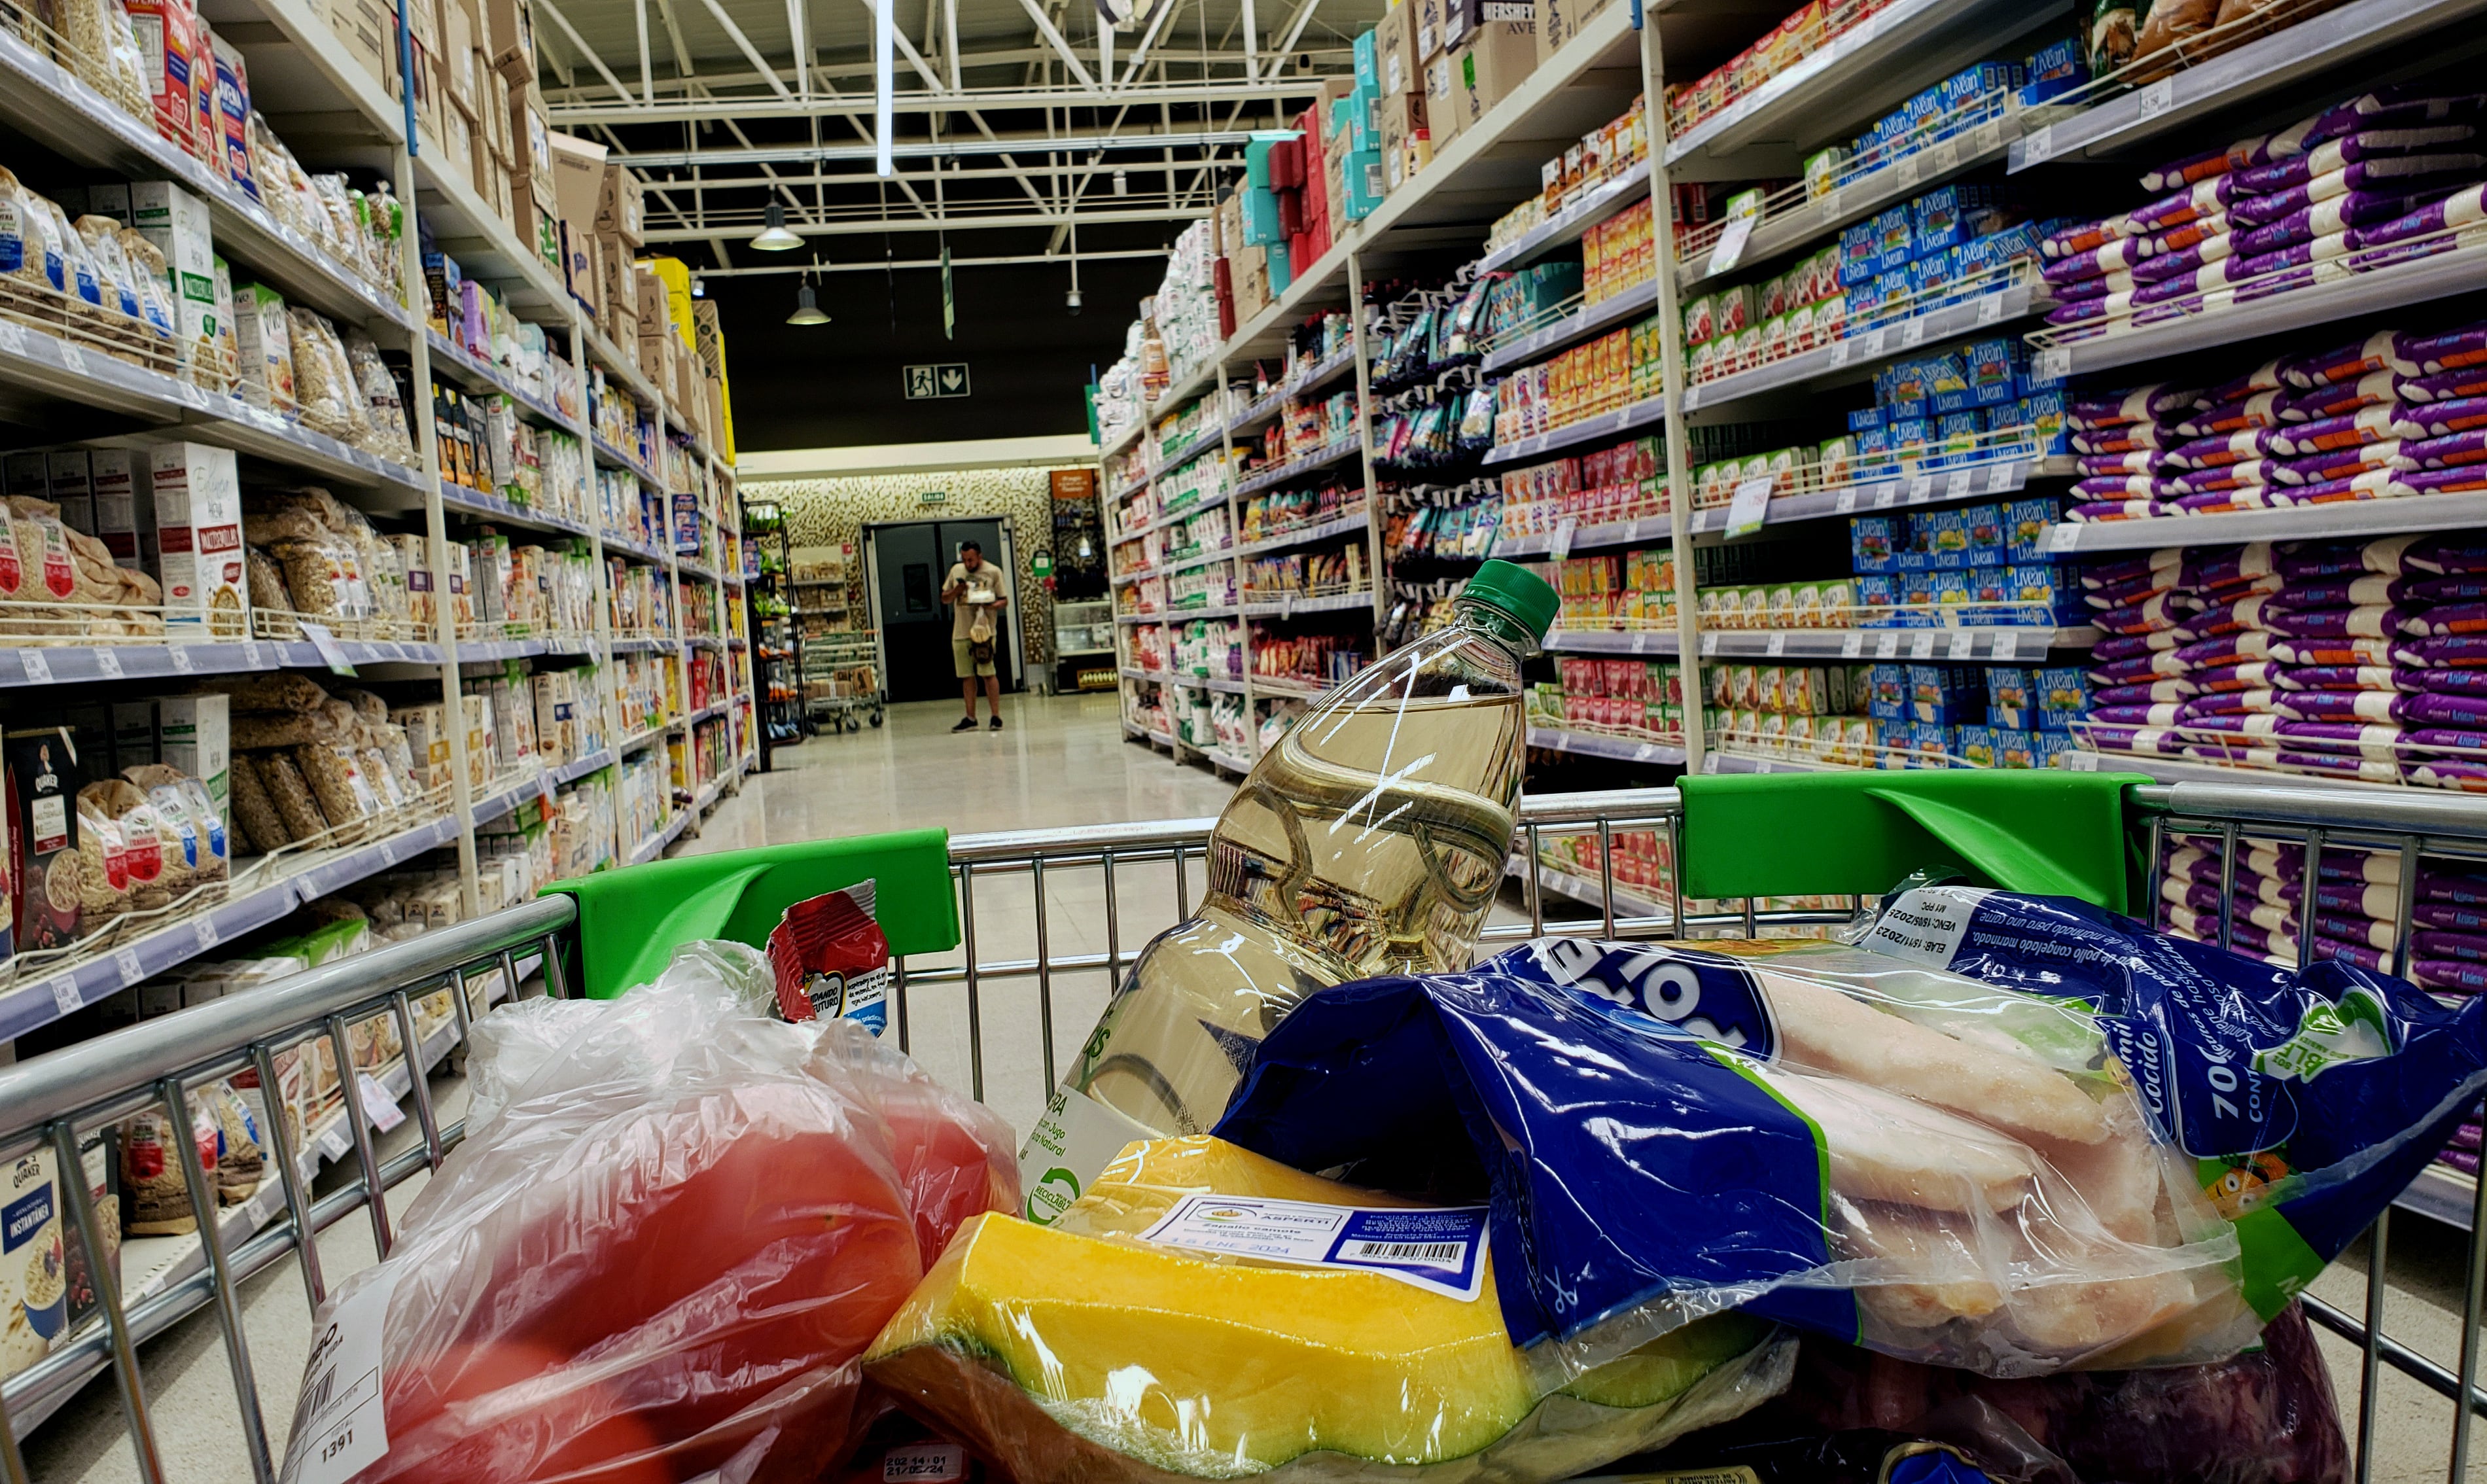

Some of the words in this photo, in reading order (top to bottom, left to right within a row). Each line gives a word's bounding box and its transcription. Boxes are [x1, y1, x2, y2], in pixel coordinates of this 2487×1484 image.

[1949, 73, 1978, 99] Livean
[1909, 92, 1937, 119] Livean
[1920, 192, 1951, 217] Livean
[1878, 211, 1903, 234] Livean
[1922, 230, 1949, 251] Livean
[1959, 242, 1987, 264] Livean
[1845, 262, 1868, 281] Livean
[1918, 258, 1944, 279] Livean
[1880, 272, 1905, 292] Livean
[1972, 344, 2003, 366] Livean
[1892, 364, 1914, 383] Livea
[1977, 383, 2003, 400] Livean
[1937, 394, 1962, 410] Livean
[2028, 395, 2058, 416] Livean
[1854, 412, 1878, 425] Livean
[1895, 424, 1920, 438] Livean
[1967, 511, 1993, 525] Livean
[2010, 504, 2044, 522] Livean
[1856, 523, 1884, 537] Livean
[1933, 516, 1960, 531] Livean
[1898, 555, 1924, 567] Livean
[1934, 554, 1959, 567] Livean
[1969, 550, 1994, 565] Livean
[1935, 574, 1963, 590] Livean
[1975, 574, 2001, 588] Livean
[2014, 569, 2046, 586] Livean
[1862, 580, 1886, 593] Livean
[1875, 669, 1897, 683] Livean
[1911, 669, 1935, 683] Livean
[1994, 673, 2019, 688] Livean
[2041, 672, 2074, 688] Livean
[1916, 727, 1940, 742] Livean
[1964, 731, 1988, 745] Livean
[1997, 734, 2025, 749] Livean
[35, 774, 58, 792] QUAKER
[1921, 902, 1935, 911] PPC
[1935, 904, 1947, 913] M1
[1888, 909, 1933, 928] 15/05/2025
[1979, 911, 2005, 925] carne
[2006, 917, 2025, 928] una
[2026, 920, 2052, 934] para
[2052, 921, 2106, 942] marinado
[1876, 926, 1922, 949] 15/11/2023
[1973, 931, 2019, 948] marinado.
[2103, 936, 2123, 946] de
[1923, 940, 1947, 953] ELAB:
[2019, 940, 2072, 958] congelado
[2073, 948, 2099, 964] pollo
[2172, 990, 2189, 1009] de
[2202, 1007, 2253, 1042] Contiene
[1048, 1123, 1066, 1140] Jugo
[1038, 1135, 1067, 1158] Natural
[13, 1163, 40, 1189] QUAKER
[1261, 1215, 1329, 1224] ASPERTI
[1254, 1226, 1301, 1234] camote
[1205, 1240, 1241, 1248] ENE
[1248, 1245, 1291, 1254] 2024
[322, 1428, 353, 1463] 1391
[887, 1466, 944, 1476] 21/05/24
